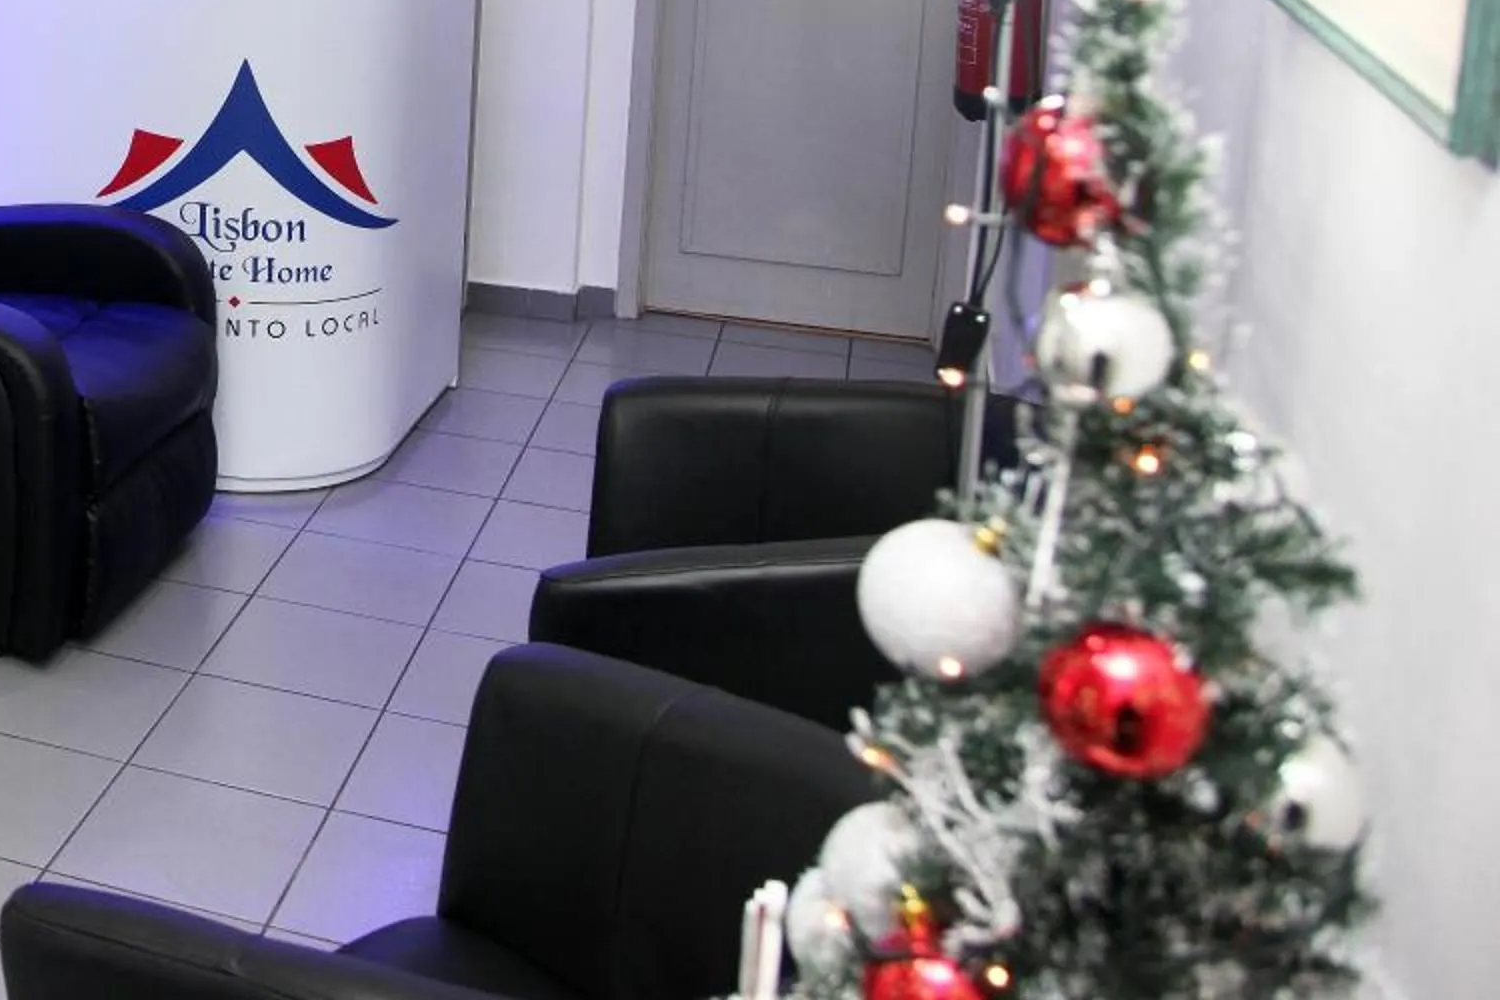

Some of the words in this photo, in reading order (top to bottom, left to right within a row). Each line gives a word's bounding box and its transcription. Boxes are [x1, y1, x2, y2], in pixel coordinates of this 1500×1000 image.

[179, 201, 306, 253] Lisbon
[242, 256, 333, 283] Home
[305, 307, 379, 338] LOCAL
